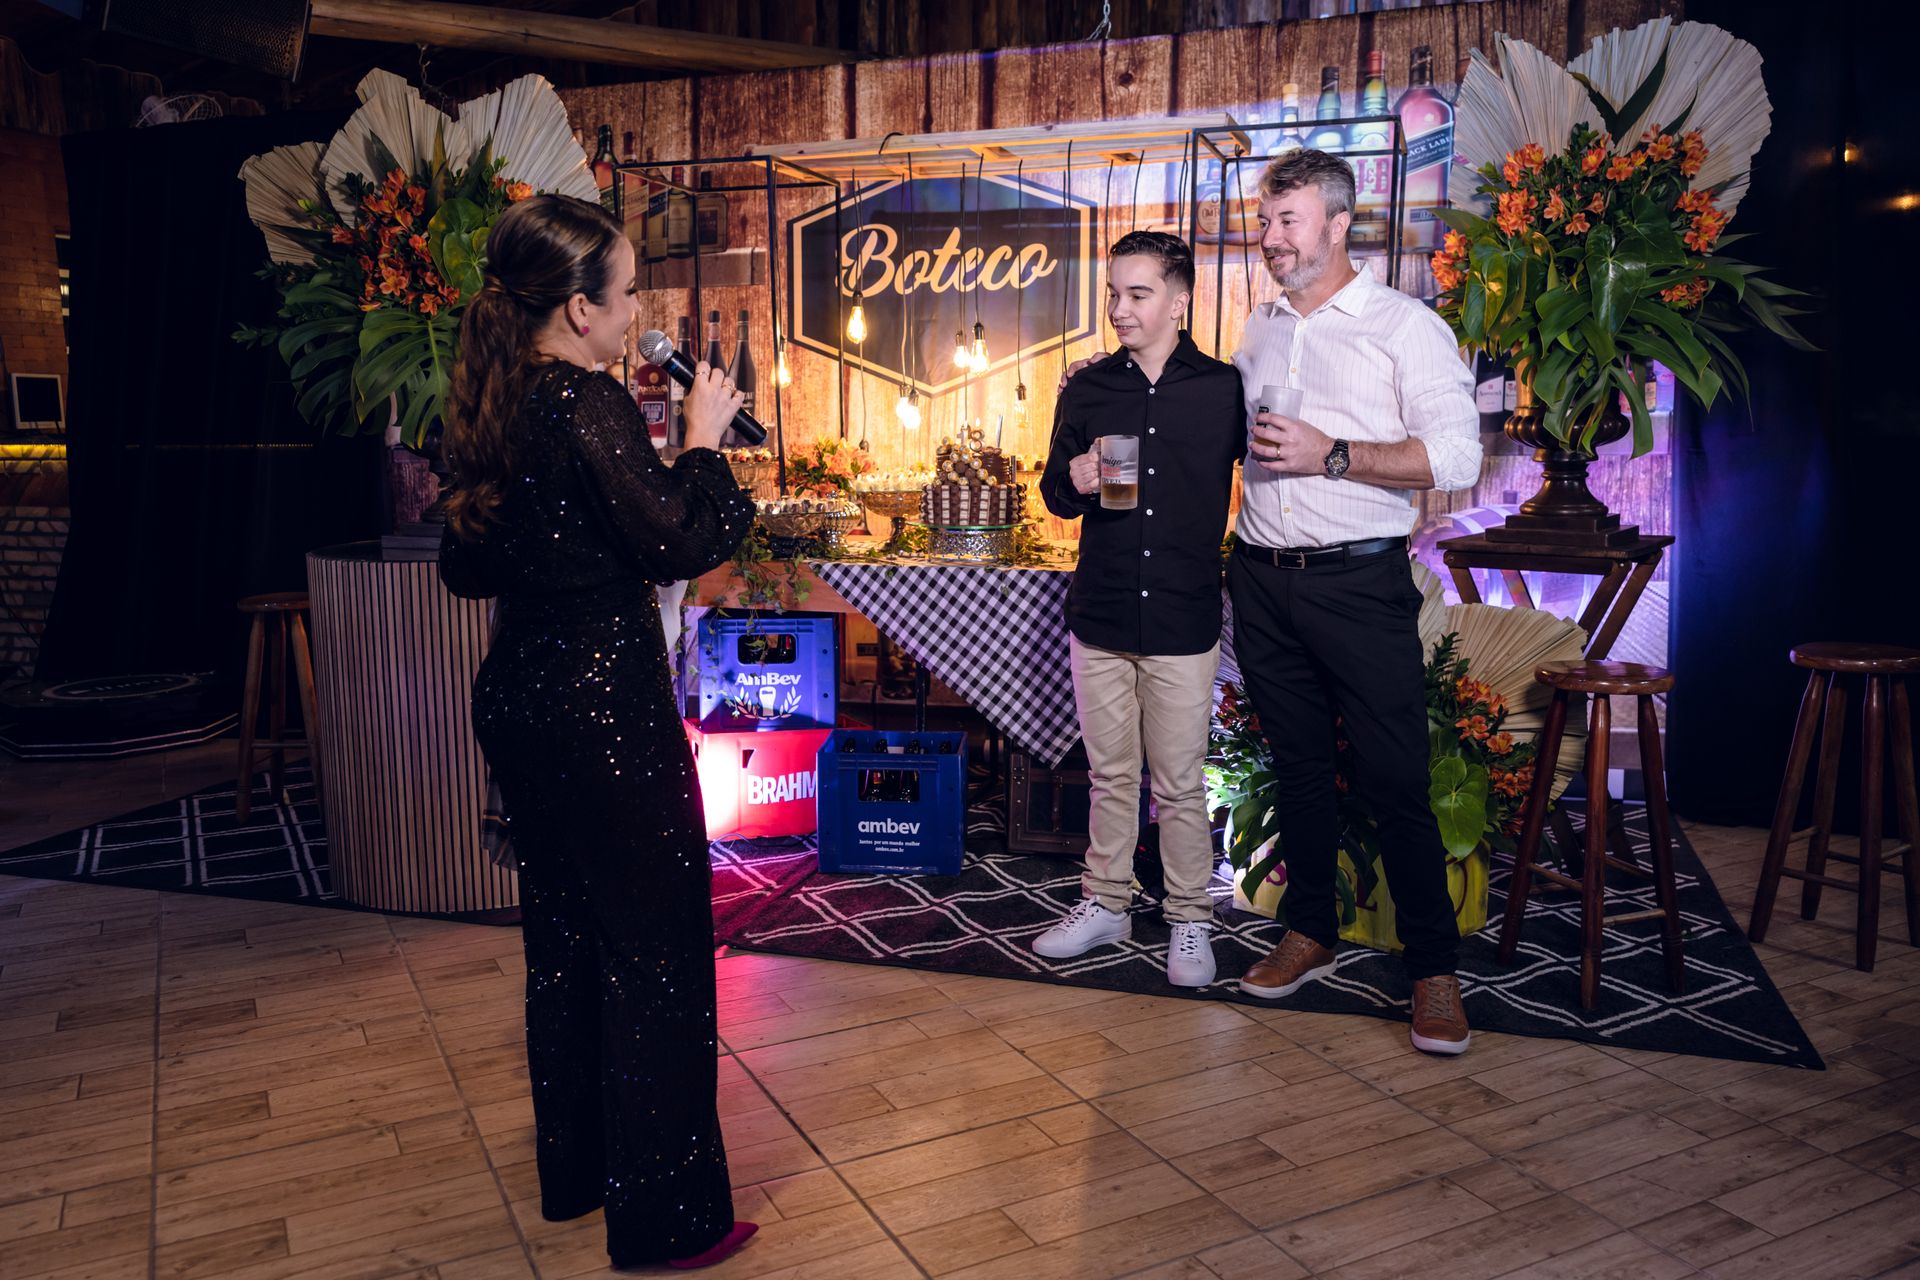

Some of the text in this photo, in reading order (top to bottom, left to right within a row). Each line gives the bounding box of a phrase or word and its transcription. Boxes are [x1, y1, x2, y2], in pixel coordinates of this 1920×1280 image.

[1406, 143, 1428, 158] ACK
[1356, 157, 1390, 195] J&B
[835, 223, 1057, 298] Boteco
[735, 672, 801, 686] AmBev
[747, 770, 817, 805] BRAHM
[857, 817, 921, 835] ambev
